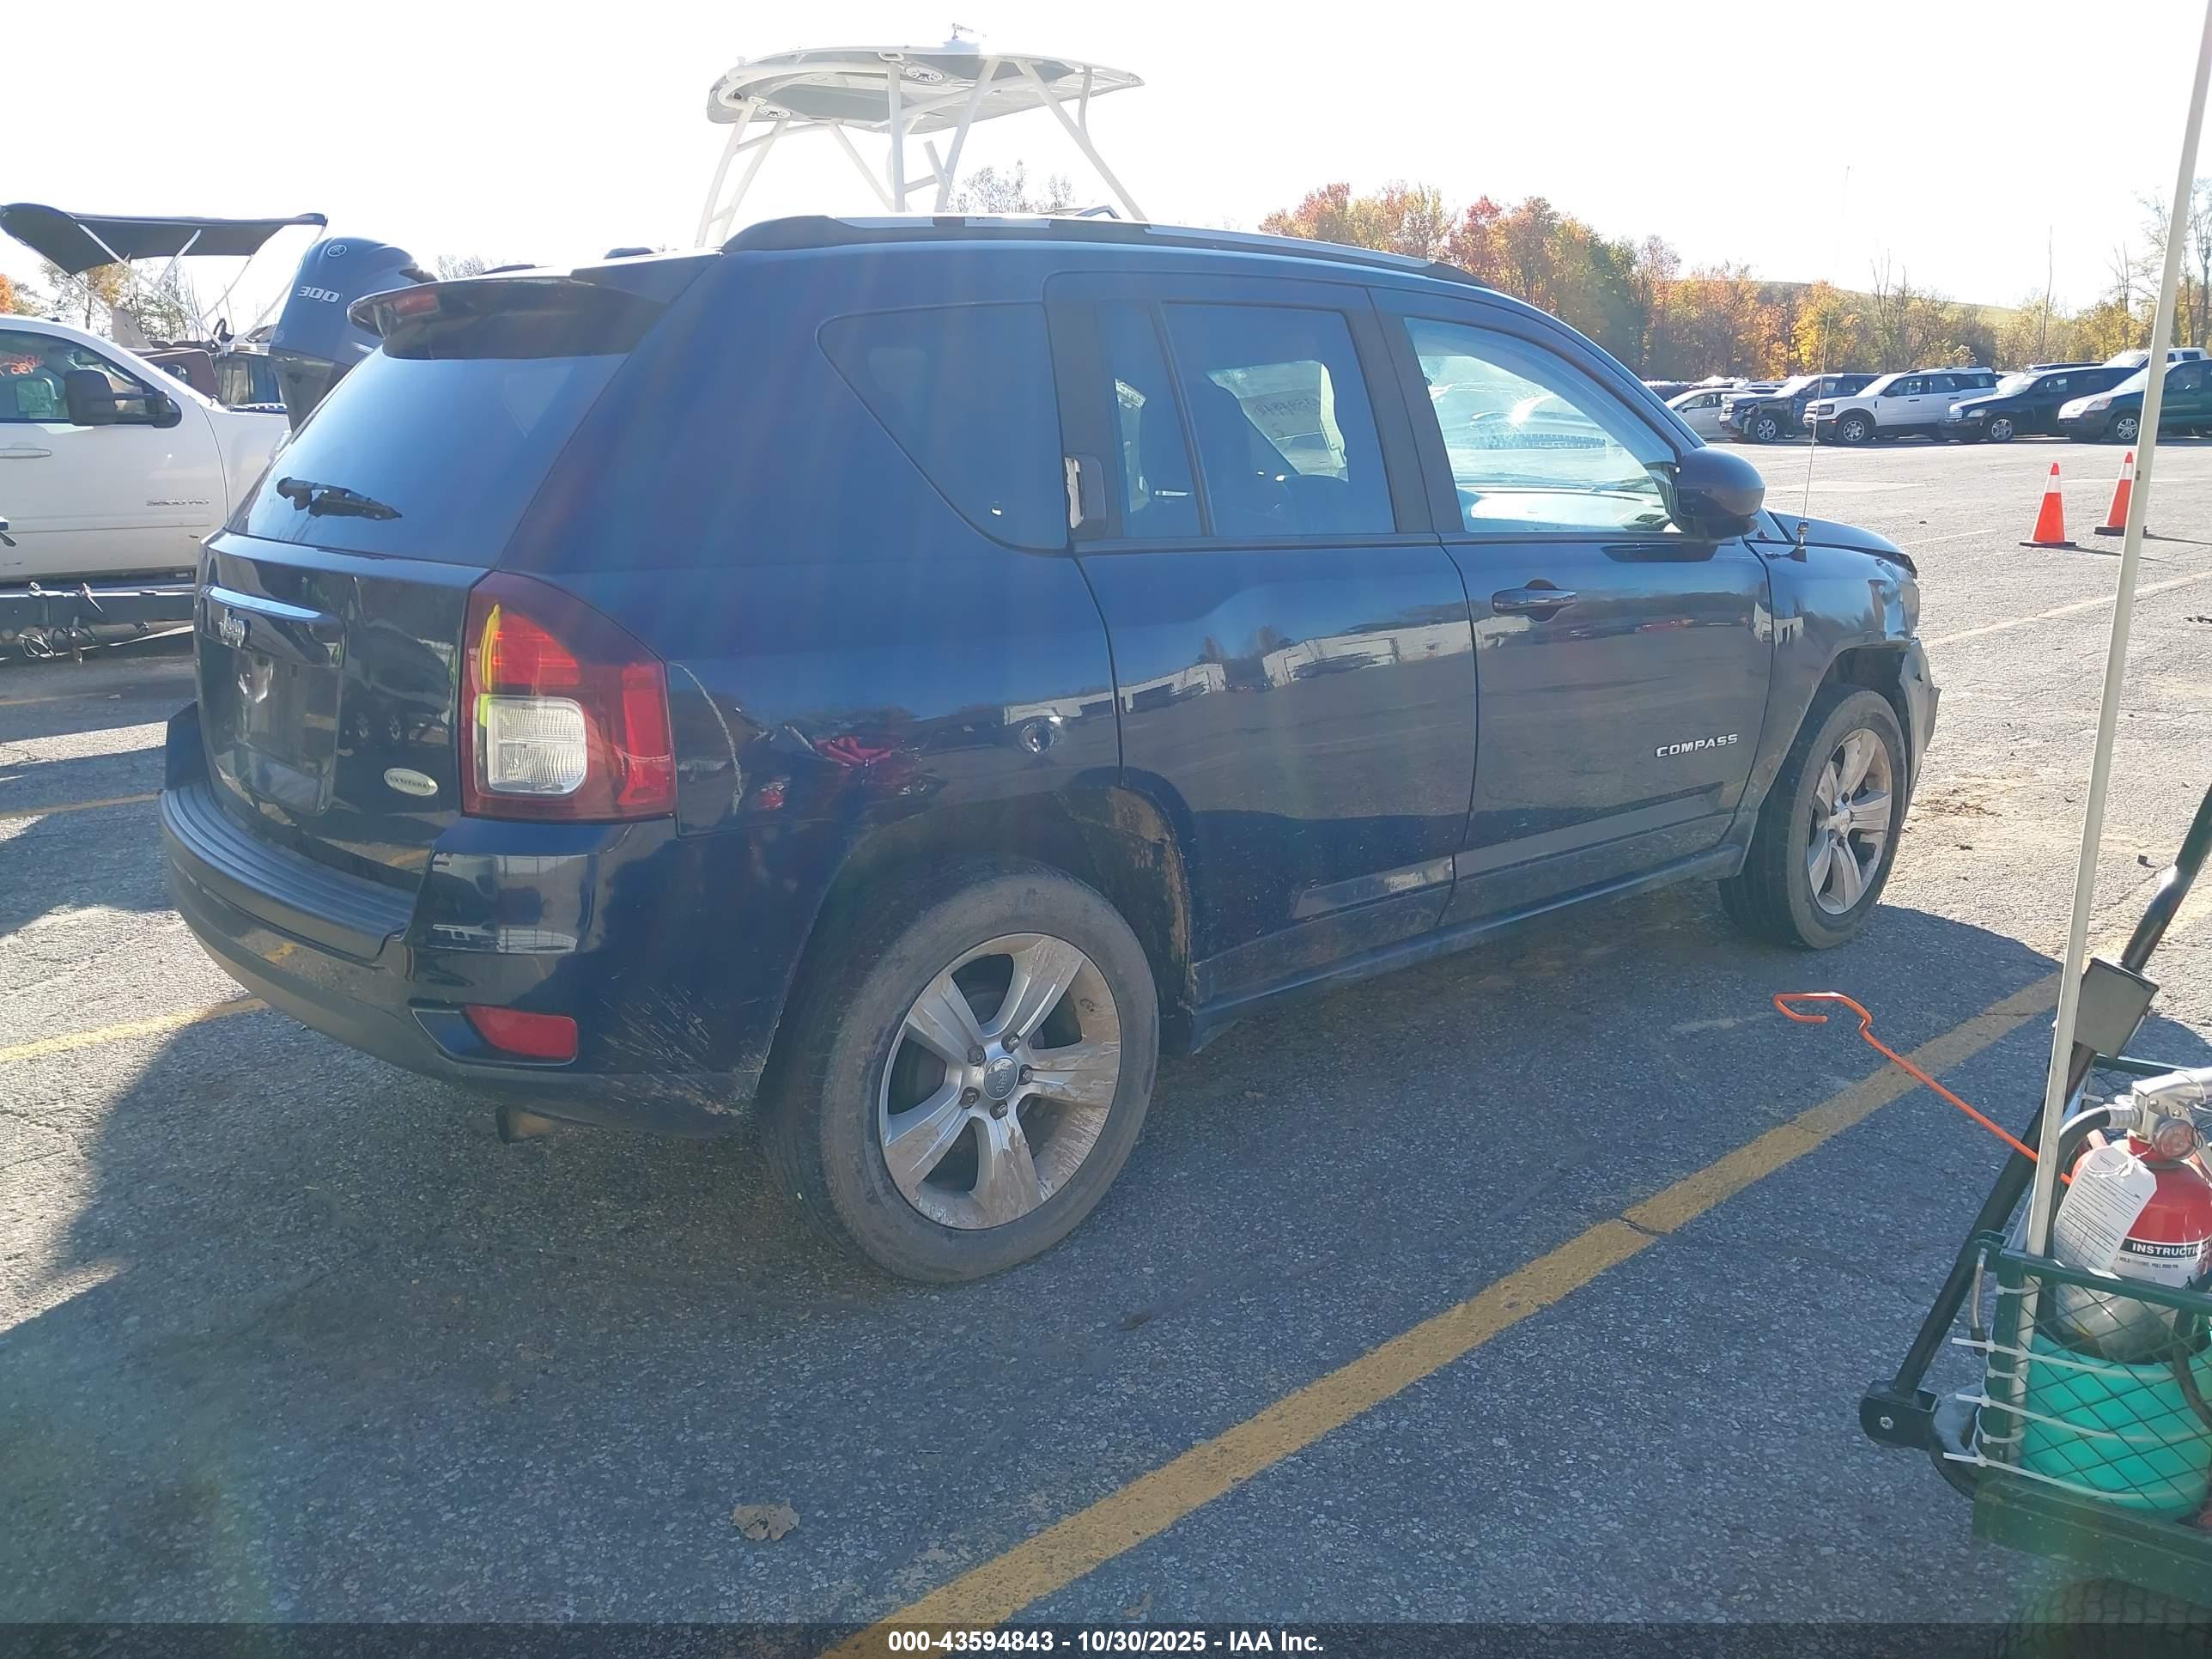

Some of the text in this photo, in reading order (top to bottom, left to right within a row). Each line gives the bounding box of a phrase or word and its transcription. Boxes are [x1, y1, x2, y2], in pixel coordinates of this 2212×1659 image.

[297, 286, 340, 302] 300
[218, 609, 246, 647] Jeep
[1656, 733, 1739, 757] COMPASS
